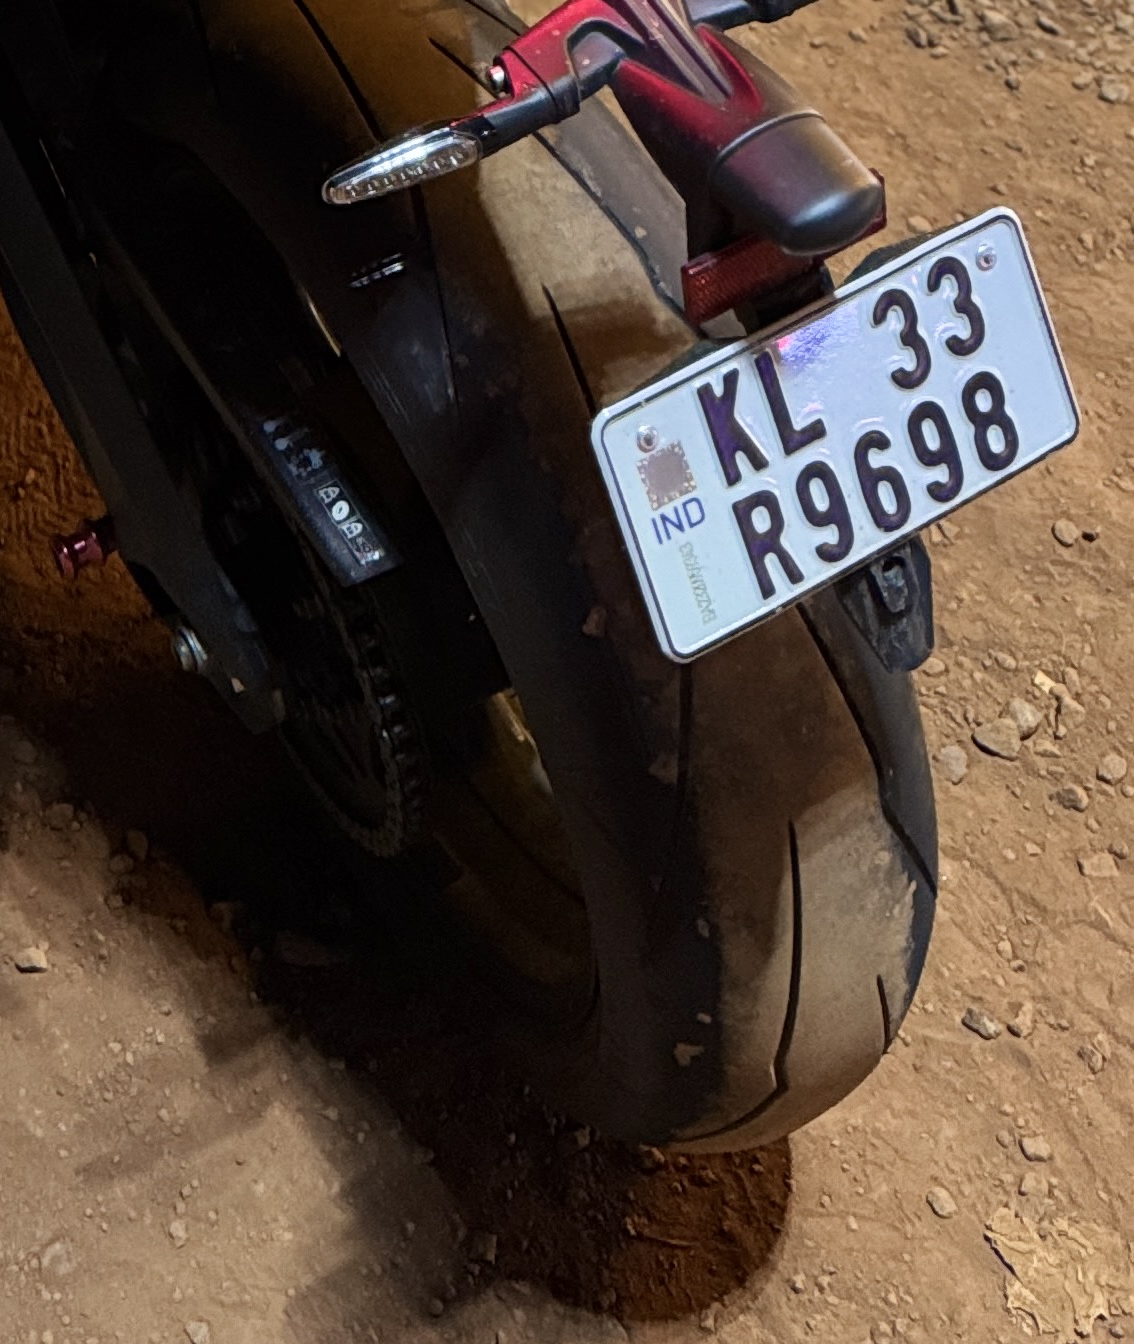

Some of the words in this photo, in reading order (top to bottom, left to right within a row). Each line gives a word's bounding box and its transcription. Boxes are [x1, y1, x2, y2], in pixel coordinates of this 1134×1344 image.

[695, 349, 826, 487] KL
[871, 255, 986, 390] 33
[731, 370, 1020, 600] R9698
[651, 497, 706, 545] IND
